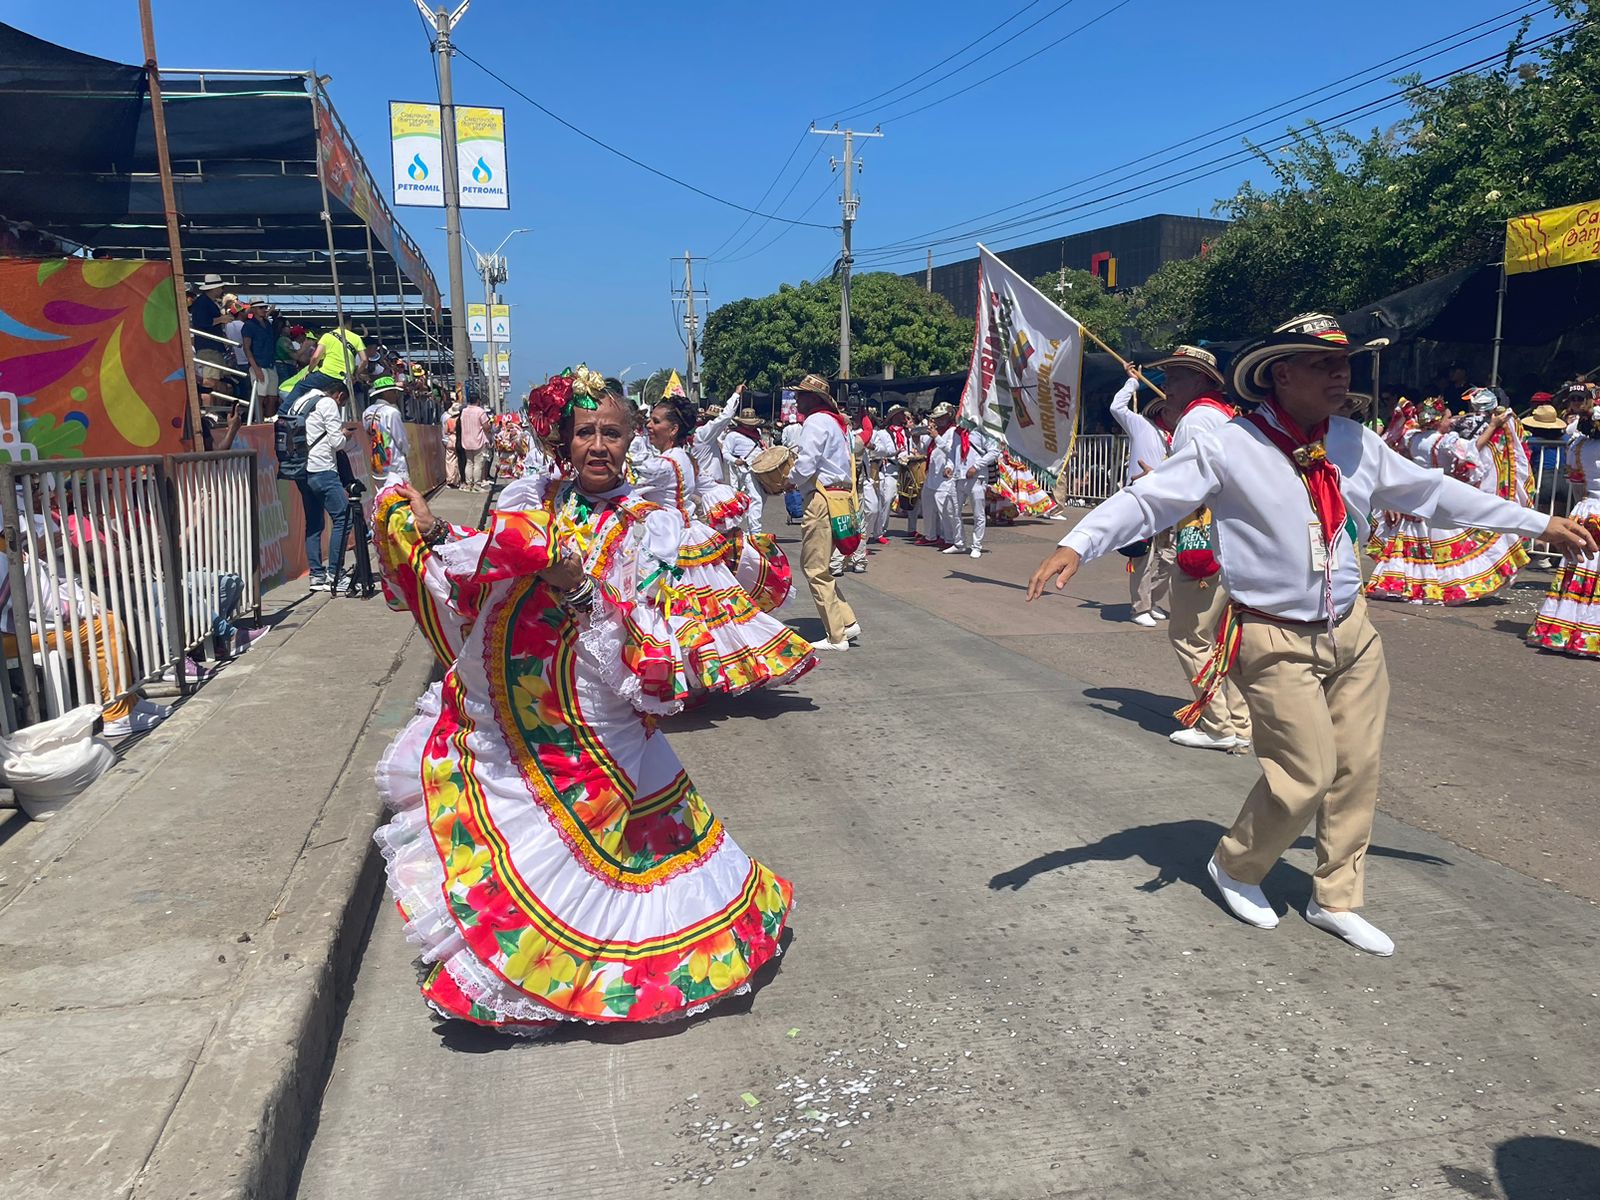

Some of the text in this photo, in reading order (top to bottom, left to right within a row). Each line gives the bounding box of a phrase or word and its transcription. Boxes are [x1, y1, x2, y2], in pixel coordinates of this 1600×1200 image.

[397, 183, 440, 192] PETROMIL
[462, 186, 504, 195] PETROMIL
[1037, 339, 1060, 454] BARRANQUILLA
[982, 402, 1013, 434] LA
